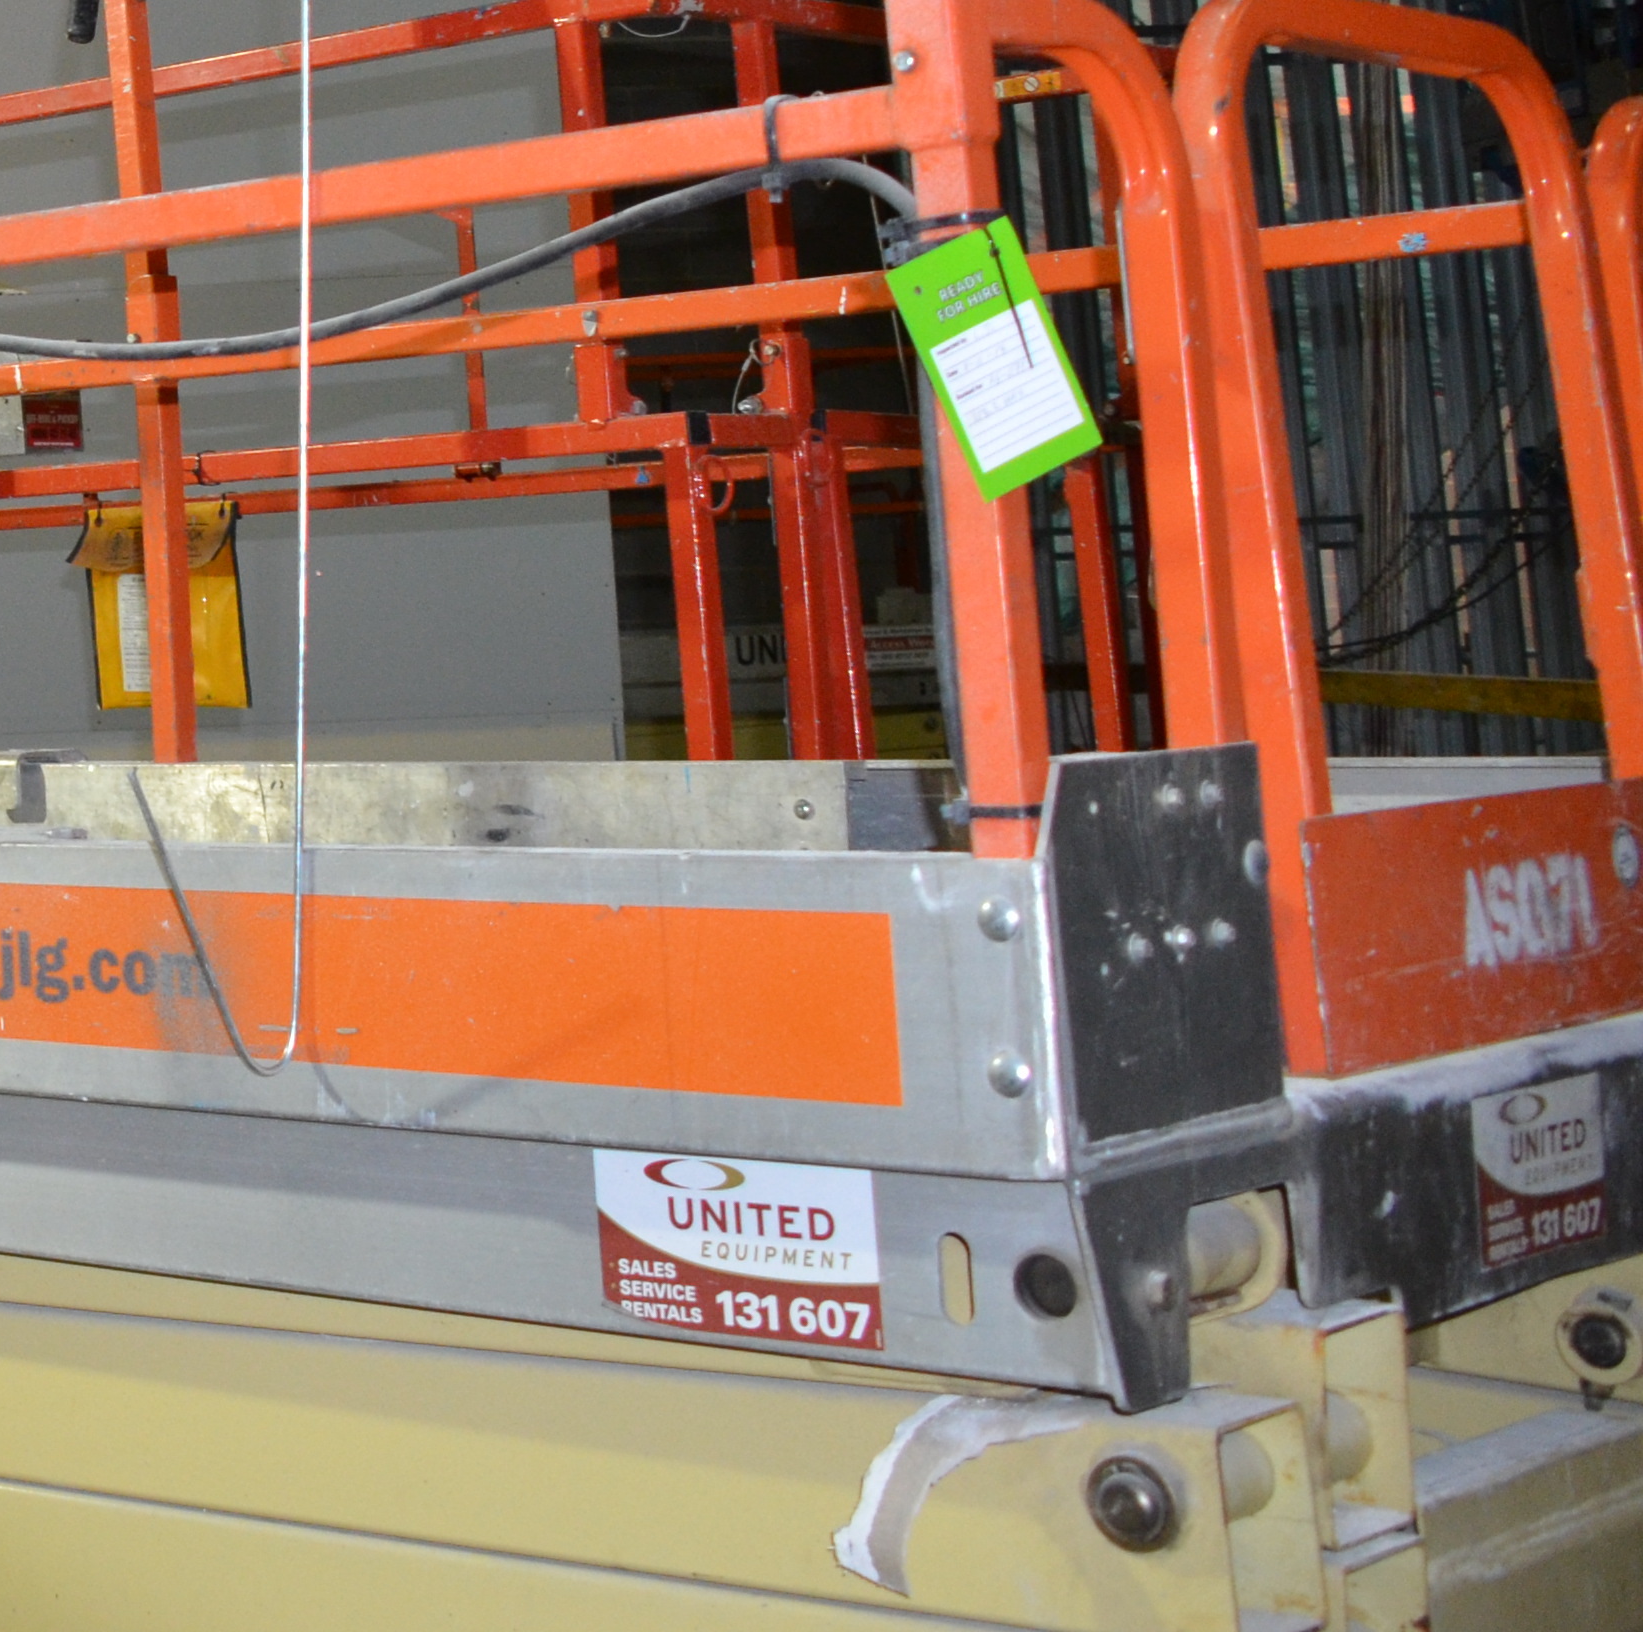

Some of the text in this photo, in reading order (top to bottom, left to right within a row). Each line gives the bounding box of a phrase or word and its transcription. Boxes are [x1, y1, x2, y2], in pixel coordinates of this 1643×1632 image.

[936, 282, 1002, 323] FOR HIRE
[938, 270, 985, 302] READY
[1509, 1118, 1586, 1164] UNITED
[666, 1196, 836, 1241] UNITED
[1531, 1197, 1602, 1246] 131 607
[618, 1258, 677, 1279] SALES
[701, 1241, 853, 1271] EQUIPMENT
[619, 1279, 697, 1303] SERVICE
[621, 1300, 704, 1325] RENTALS
[715, 1290, 781, 1332] 131
[788, 1298, 871, 1340] 607
